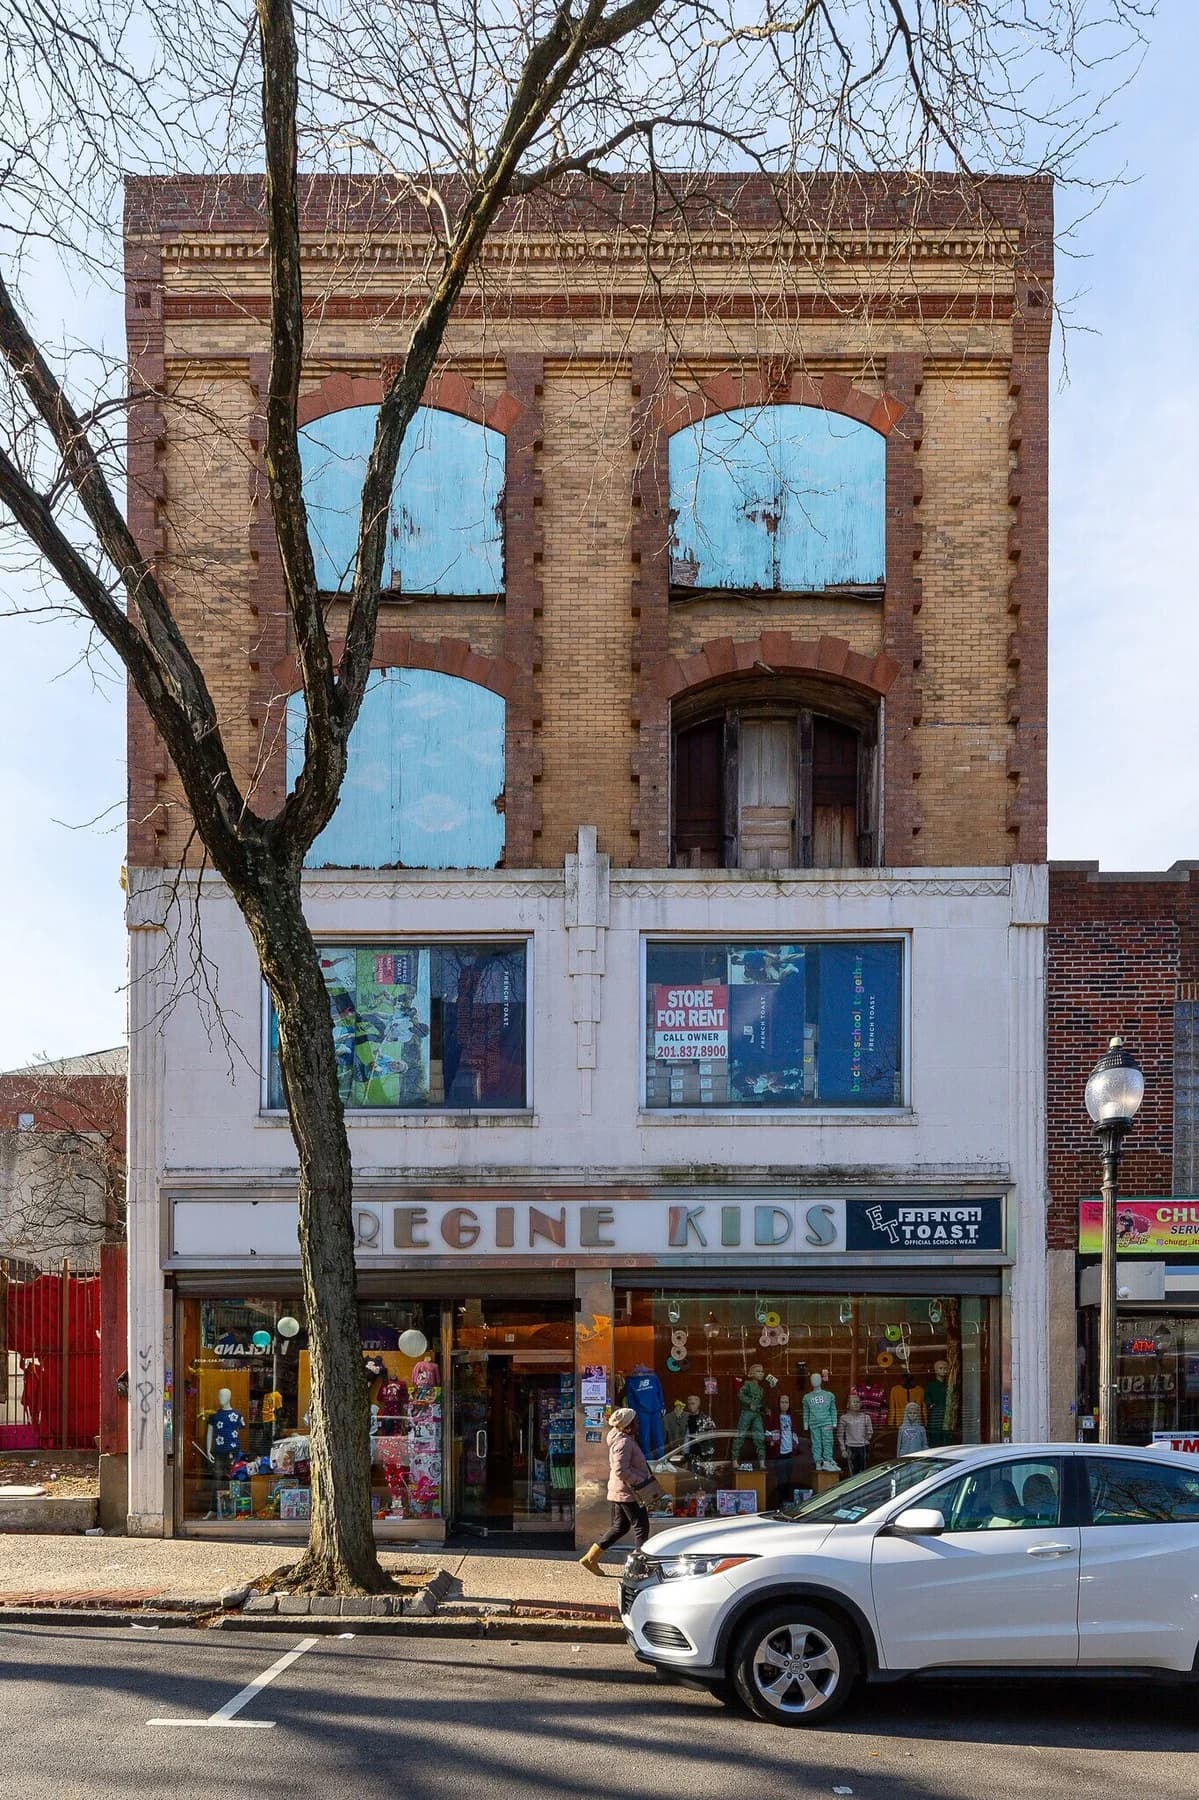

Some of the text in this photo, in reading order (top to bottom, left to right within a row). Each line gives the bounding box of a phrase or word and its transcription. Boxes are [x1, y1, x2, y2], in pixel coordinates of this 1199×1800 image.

[667, 989, 714, 1009] STORE
[656, 1008, 726, 1028] FOR RENT
[663, 1032, 719, 1042] CALL OWNER
[657, 1044, 726, 1059] 201.837.8900
[901, 1209, 980, 1221] FRENCH
[668, 1203, 840, 1248] KIDS
[1132, 1340, 1155, 1352] ATM
